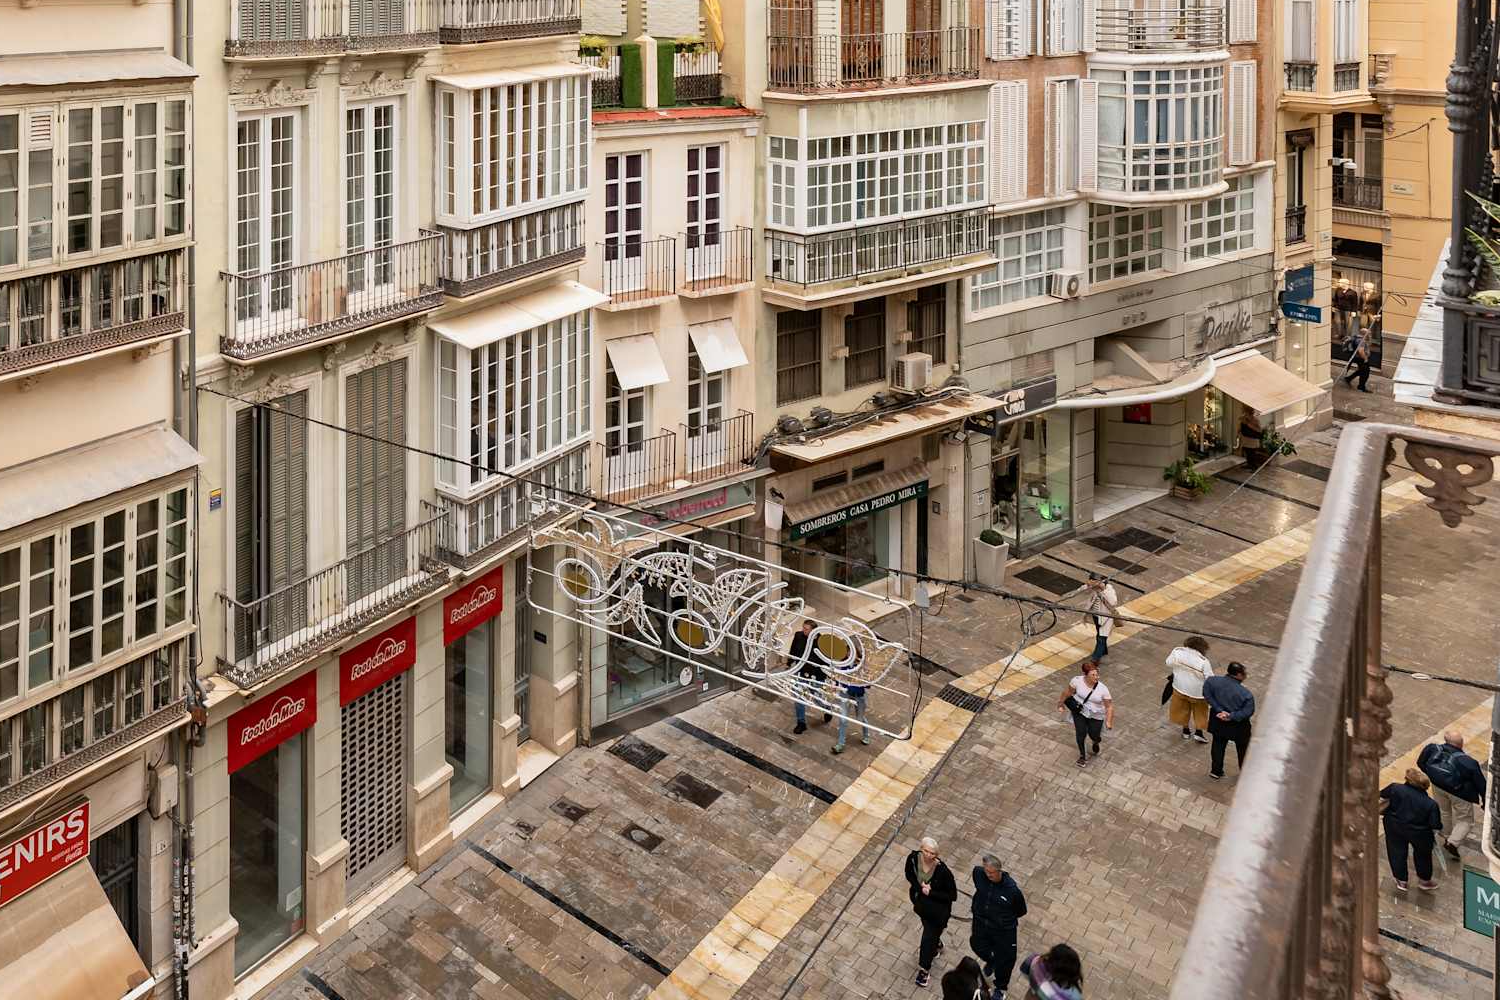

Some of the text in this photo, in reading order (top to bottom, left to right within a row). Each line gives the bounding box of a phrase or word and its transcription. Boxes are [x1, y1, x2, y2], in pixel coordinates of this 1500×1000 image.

[800, 486, 917, 534] SOMBREROS CASA PEDRO MIRA
[450, 588, 497, 625] Foot on Mars
[351, 657, 372, 681] Foot
[371, 652, 384, 669] on
[383, 640, 406, 662] Mars
[241, 718, 265, 746] Foot
[265, 712, 280, 731] on
[279, 698, 305, 722] Mars
